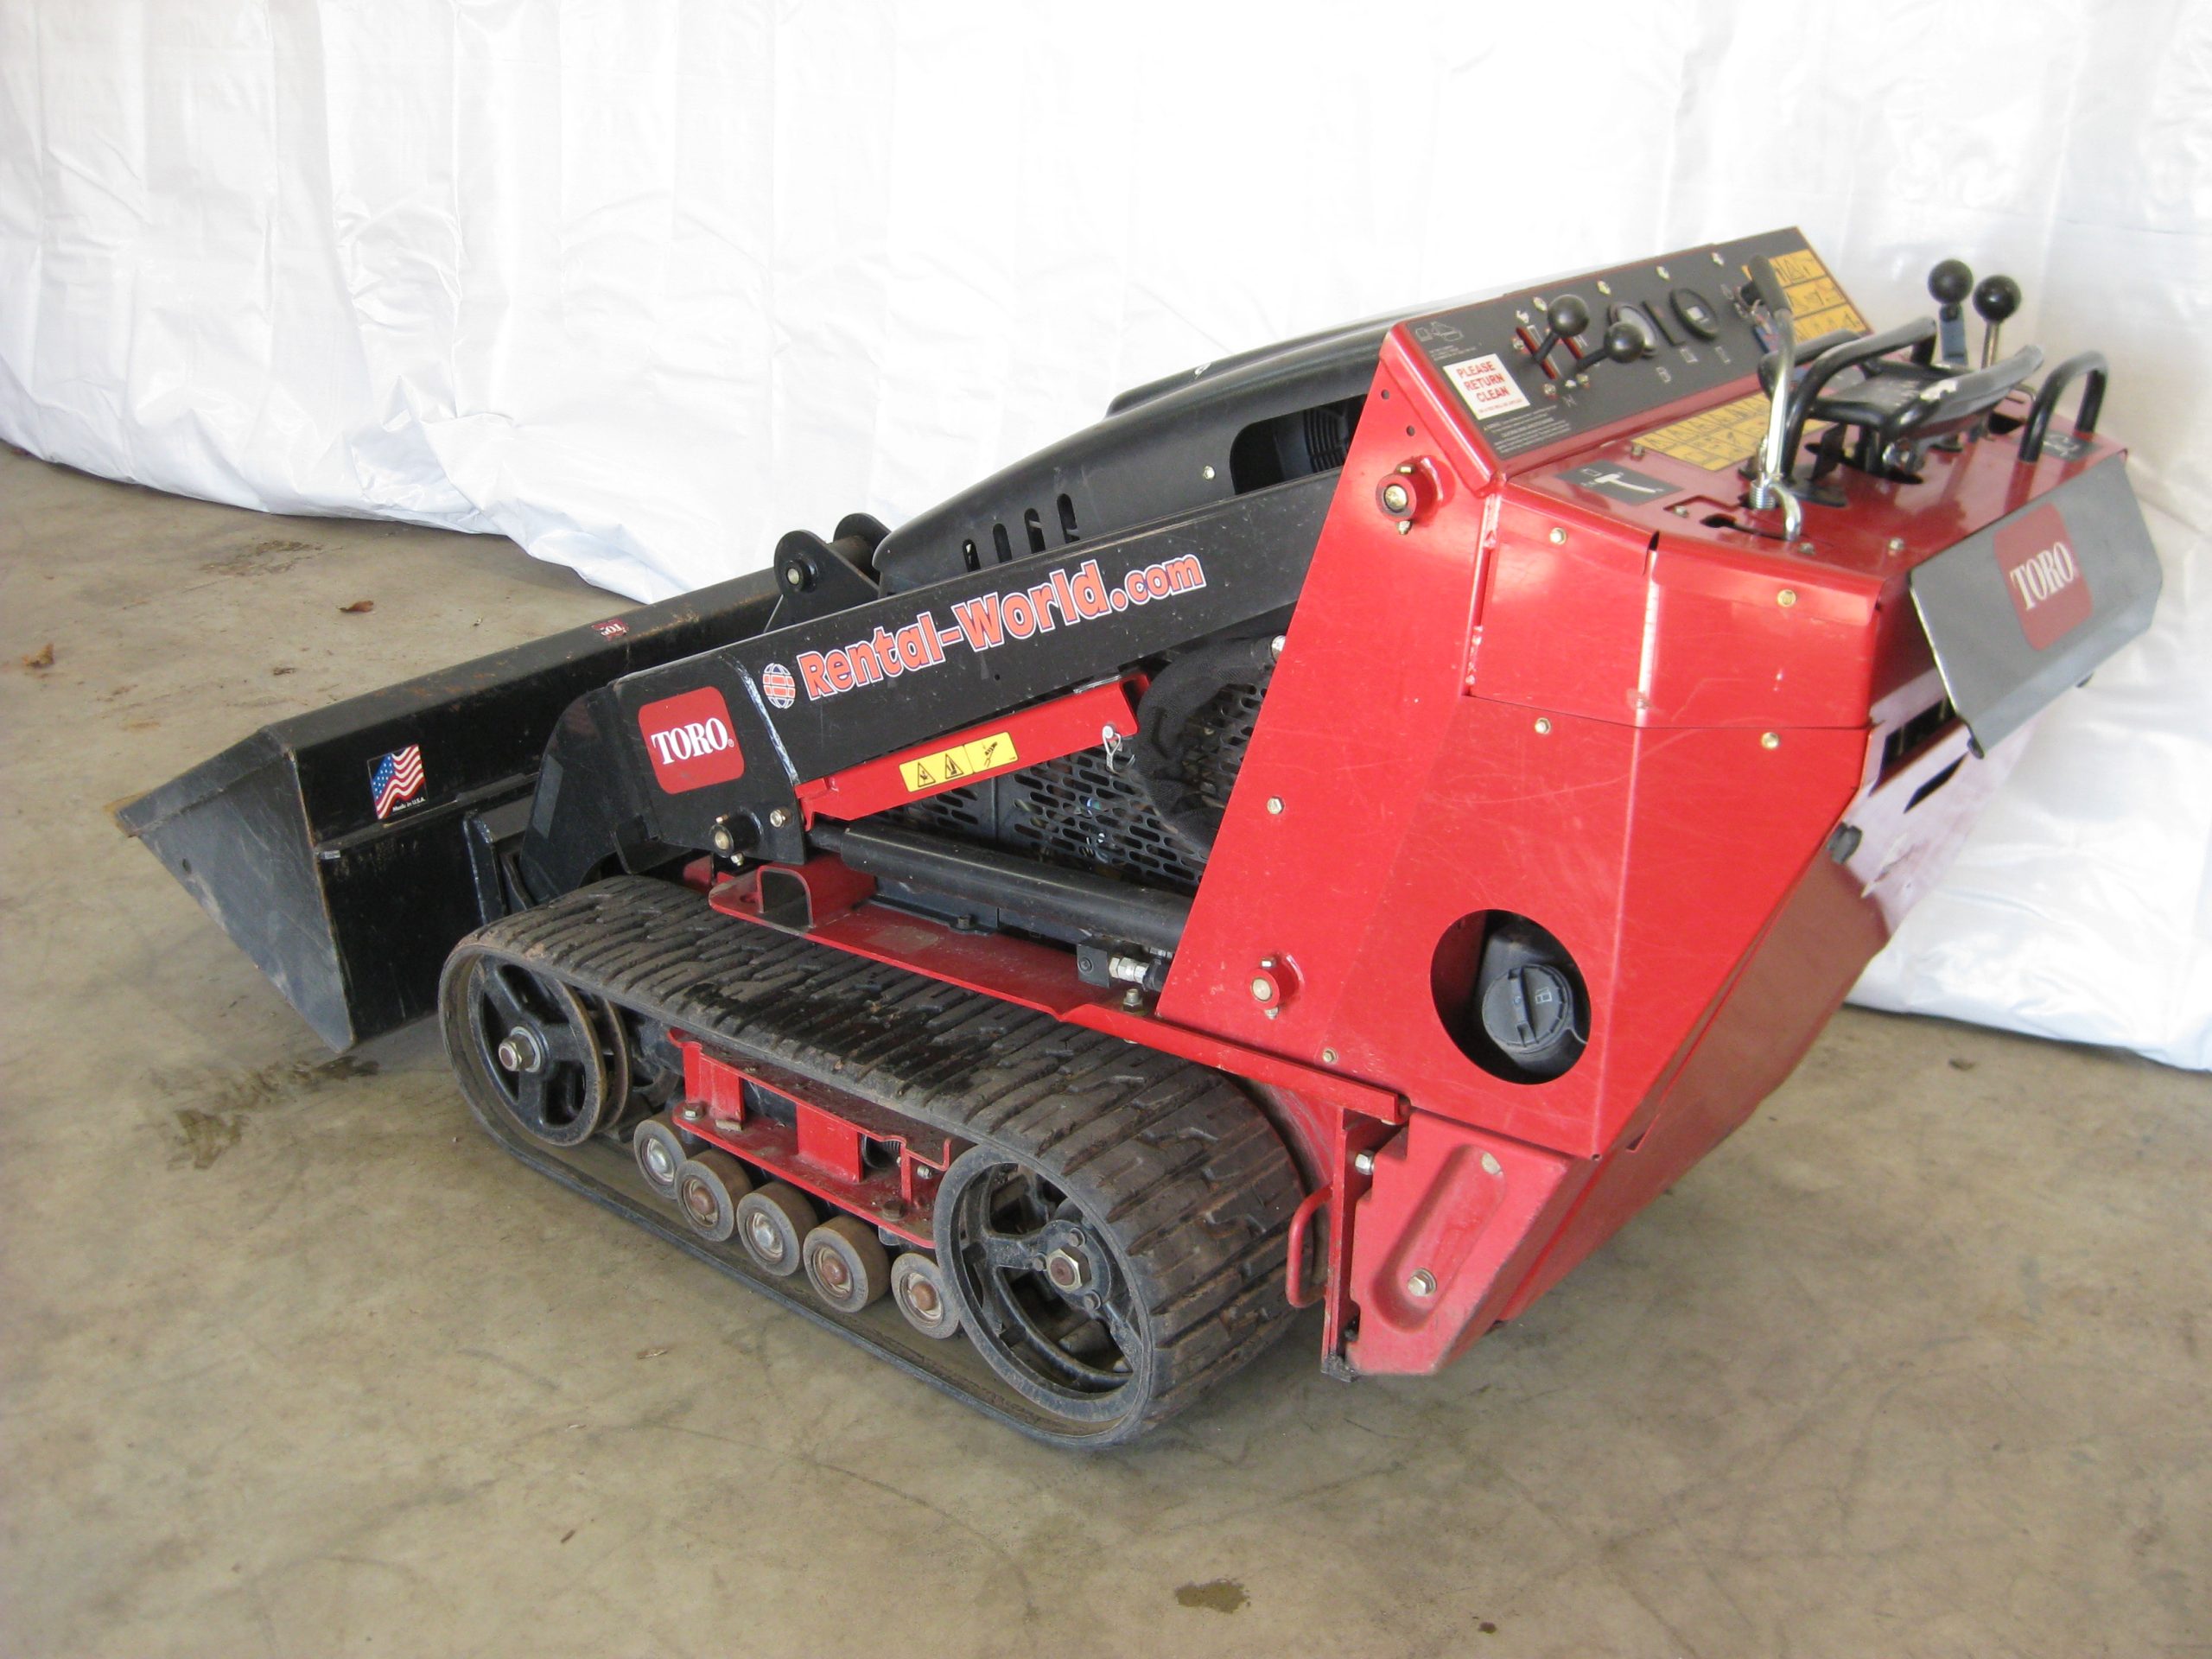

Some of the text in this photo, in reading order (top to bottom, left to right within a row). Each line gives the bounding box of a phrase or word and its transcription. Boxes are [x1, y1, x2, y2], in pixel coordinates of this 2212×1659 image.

[1456, 360, 1496, 378] PLEASE
[1464, 373, 1505, 391] RETURN
[1476, 386, 1510, 403] CLEAN
[2009, 542, 2074, 610] TORO
[797, 554, 1207, 702] Rental-World.com
